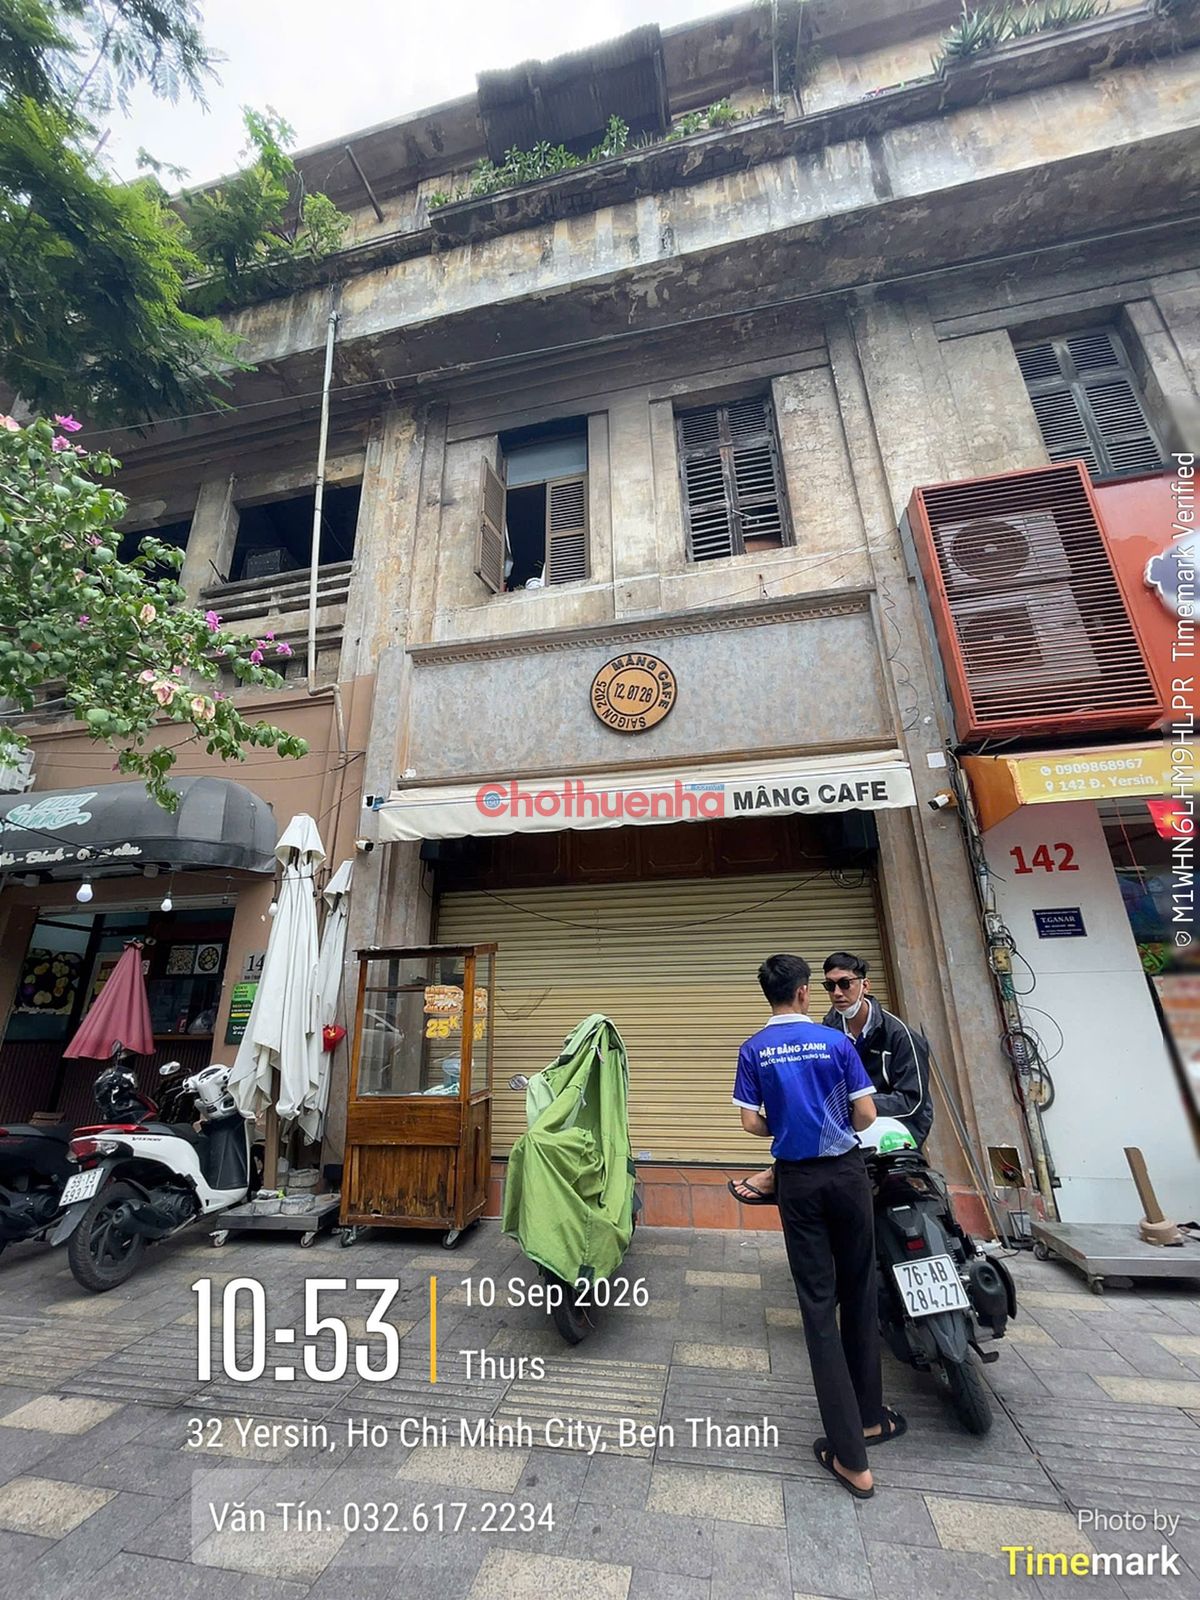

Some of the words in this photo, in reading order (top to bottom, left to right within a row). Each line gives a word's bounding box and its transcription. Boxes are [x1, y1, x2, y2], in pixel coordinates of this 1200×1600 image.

[594, 680, 607, 708] 2025
[611, 654, 657, 671] MÂNG
[658, 670, 673, 709] CAFE
[639, 687, 653, 702] 26
[602, 708, 647, 728] SAIGON
[1056, 758, 1143, 775] 0909868967
[733, 785, 810, 811] MÂNG
[818, 781, 888, 803] CAFE
[1059, 778, 1086, 791] 142
[1108, 774, 1159, 787] Yersin,
[1010, 843, 1080, 874] 142
[802, 1042, 826, 1051] XANH
[903, 1261, 948, 1288] 76-AB
[906, 1282, 960, 1312] 284.27
